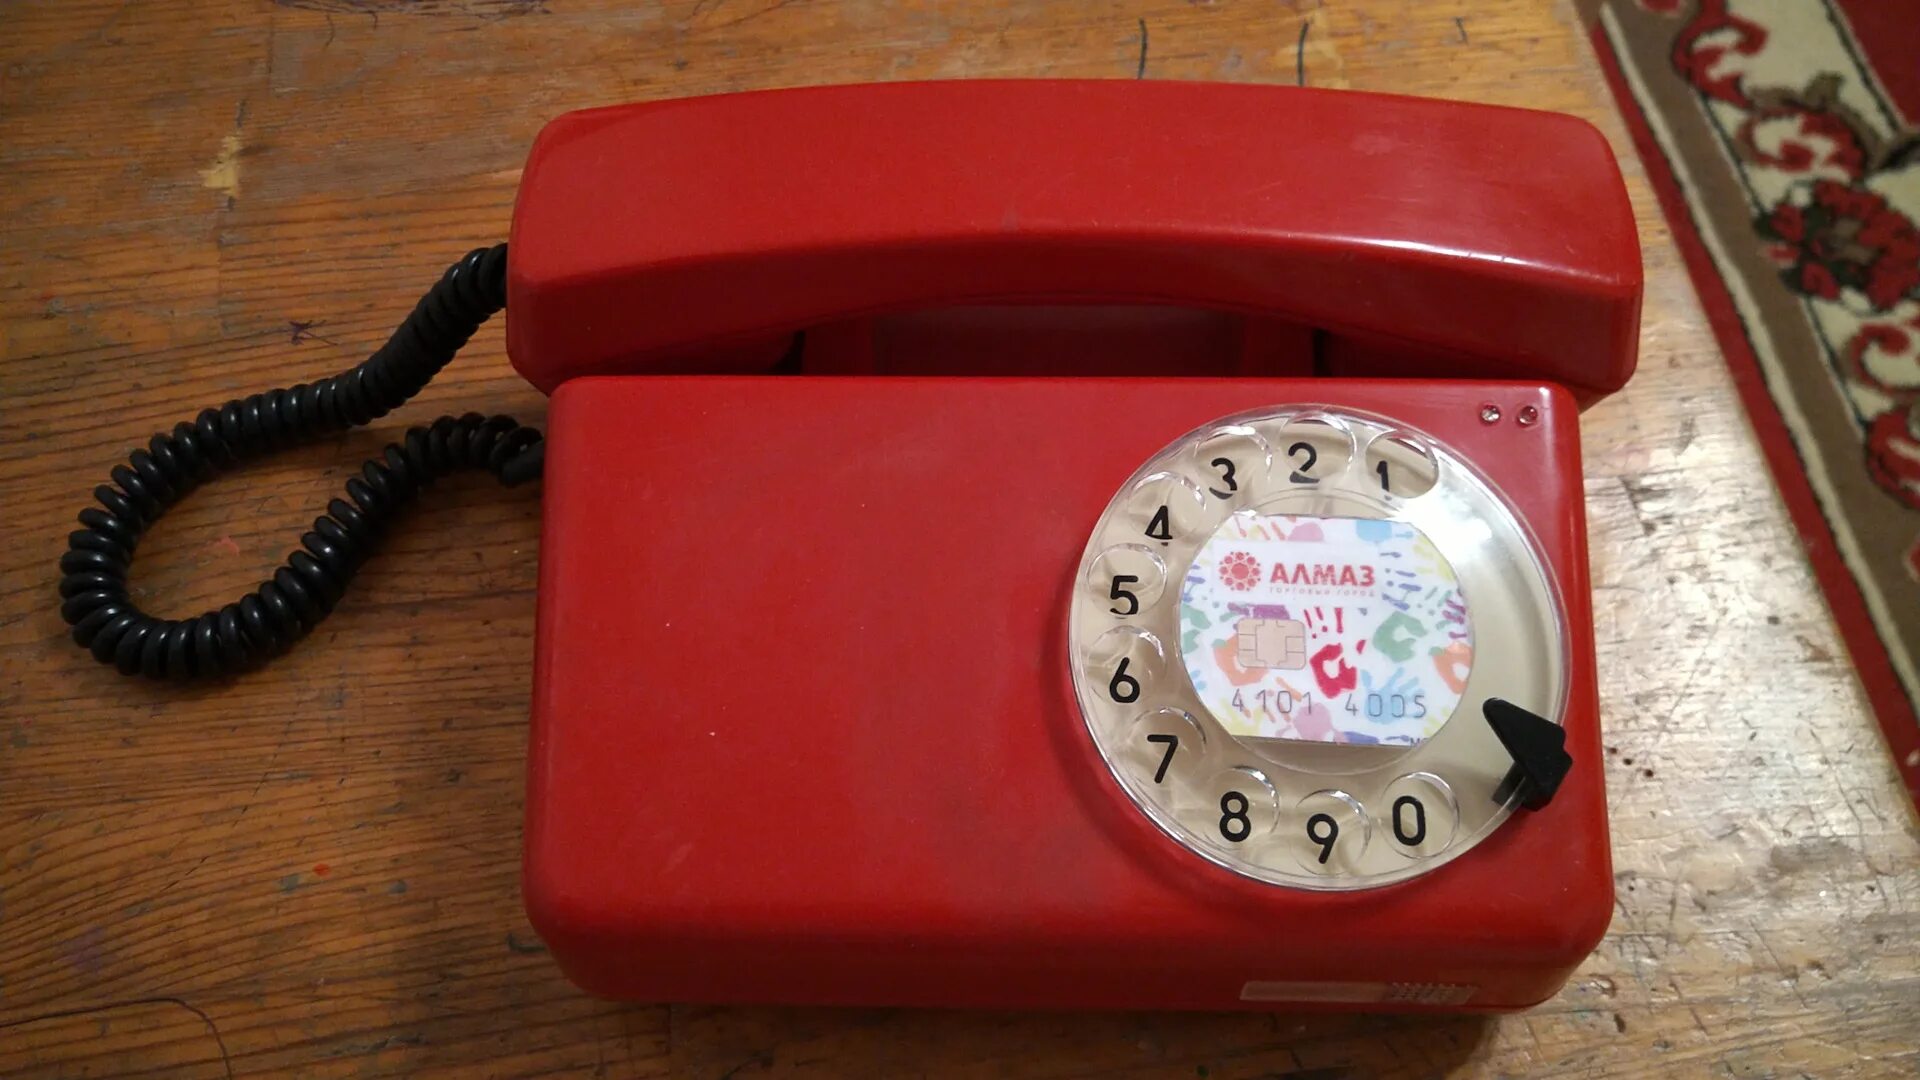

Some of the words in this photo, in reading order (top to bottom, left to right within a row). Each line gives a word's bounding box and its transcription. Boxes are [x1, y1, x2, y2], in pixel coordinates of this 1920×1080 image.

[1208, 457, 1238, 500] 3
[1287, 441, 1320, 484] 2
[1375, 459, 1391, 501] 1
[1144, 505, 1174, 546] 4
[1109, 575, 1140, 616] 5
[1270, 562, 1375, 587] АЛМАЗ
[1109, 657, 1141, 704] 6
[1231, 688, 1314, 715] 4101
[1344, 693, 1427, 719] 4005
[1146, 734, 1179, 784] 7
[1219, 791, 1252, 843] 8
[1392, 795, 1426, 847] 0
[1306, 813, 1339, 865] 9
